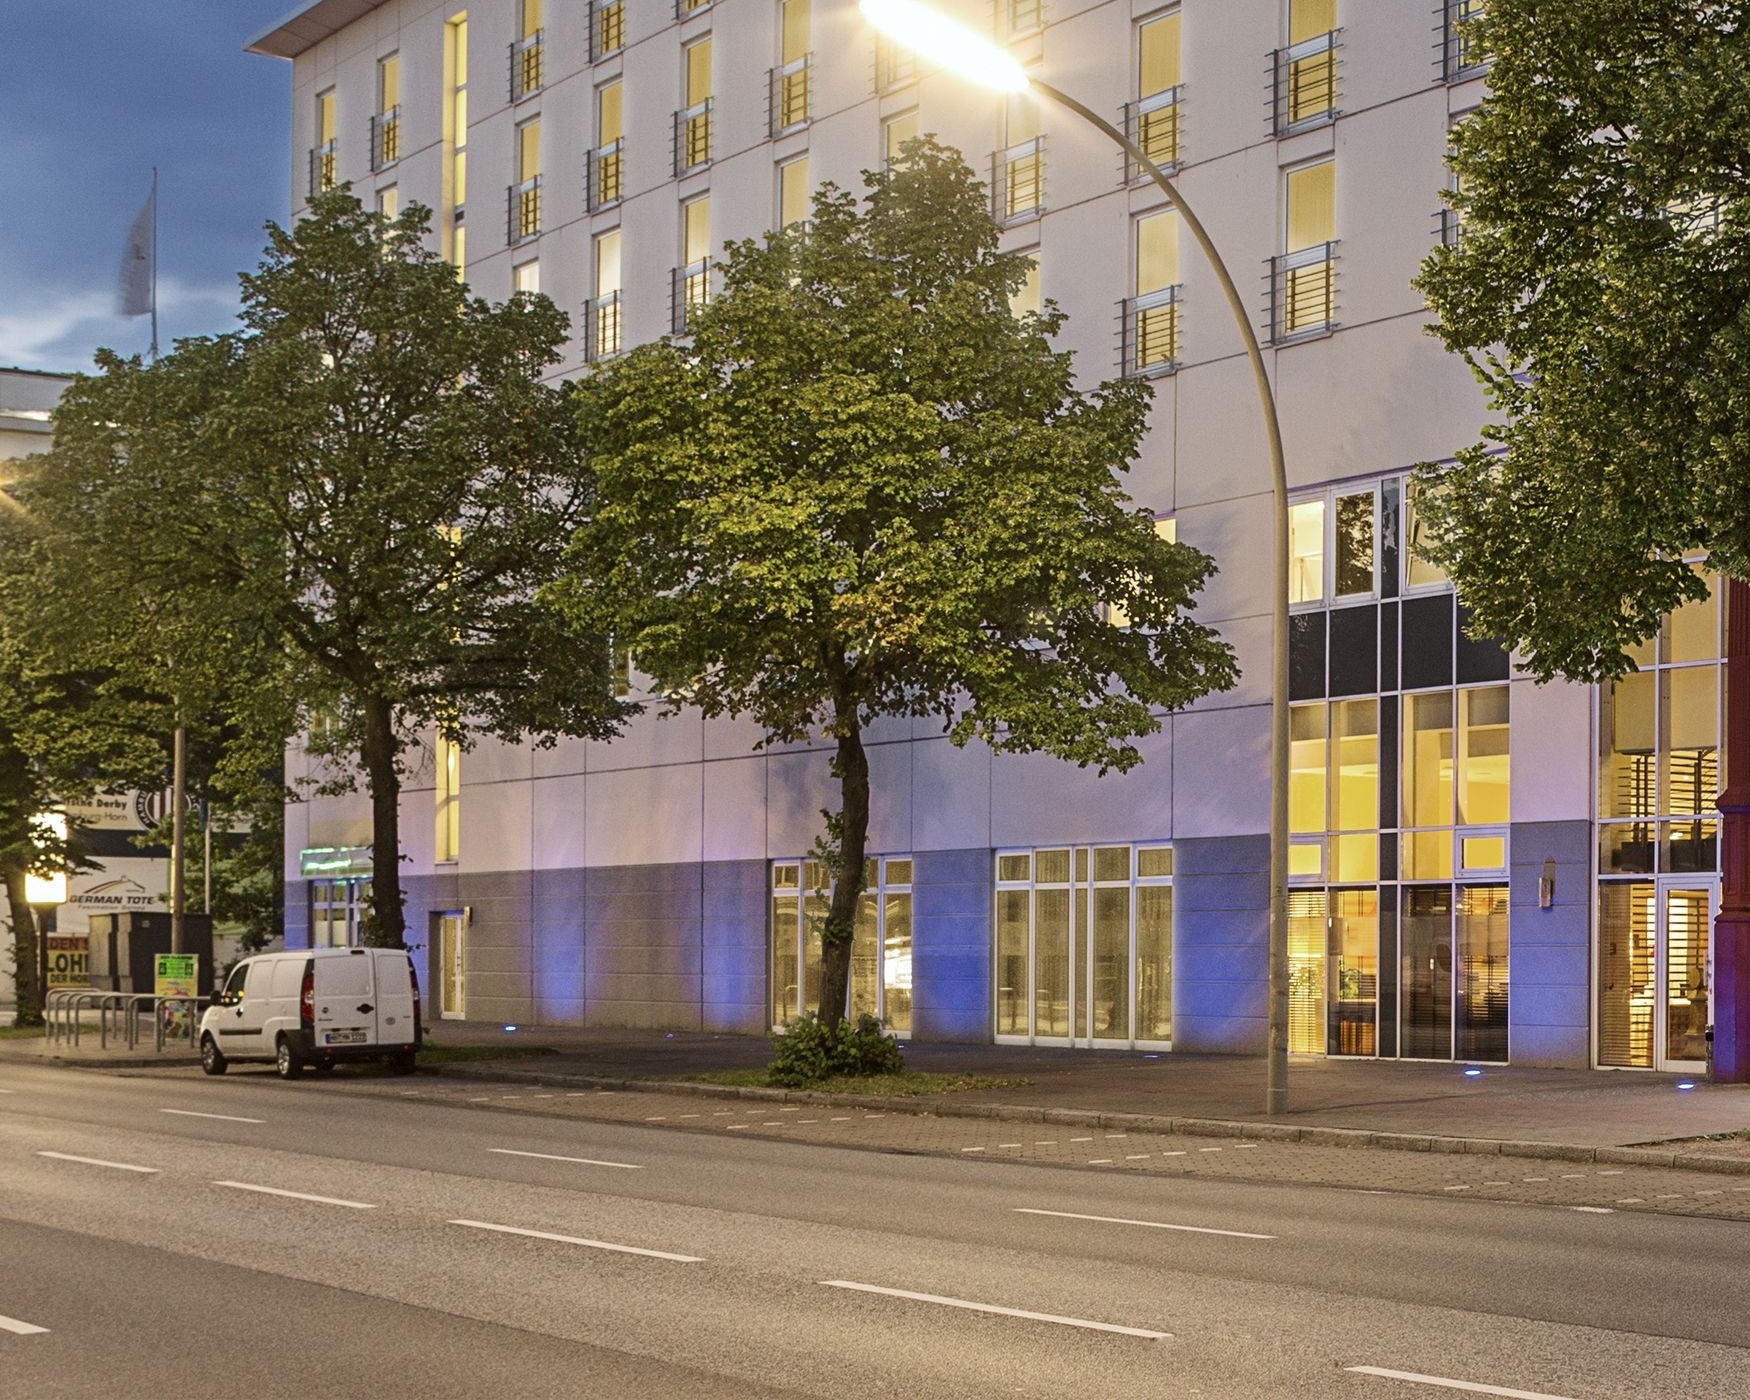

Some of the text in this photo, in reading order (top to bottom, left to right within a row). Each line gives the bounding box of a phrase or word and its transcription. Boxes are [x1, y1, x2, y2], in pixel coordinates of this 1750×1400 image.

[96, 798, 127, 810] Derby
[69, 895, 154, 905] GERMAN TOTE
[70, 974, 89, 983] HOR
